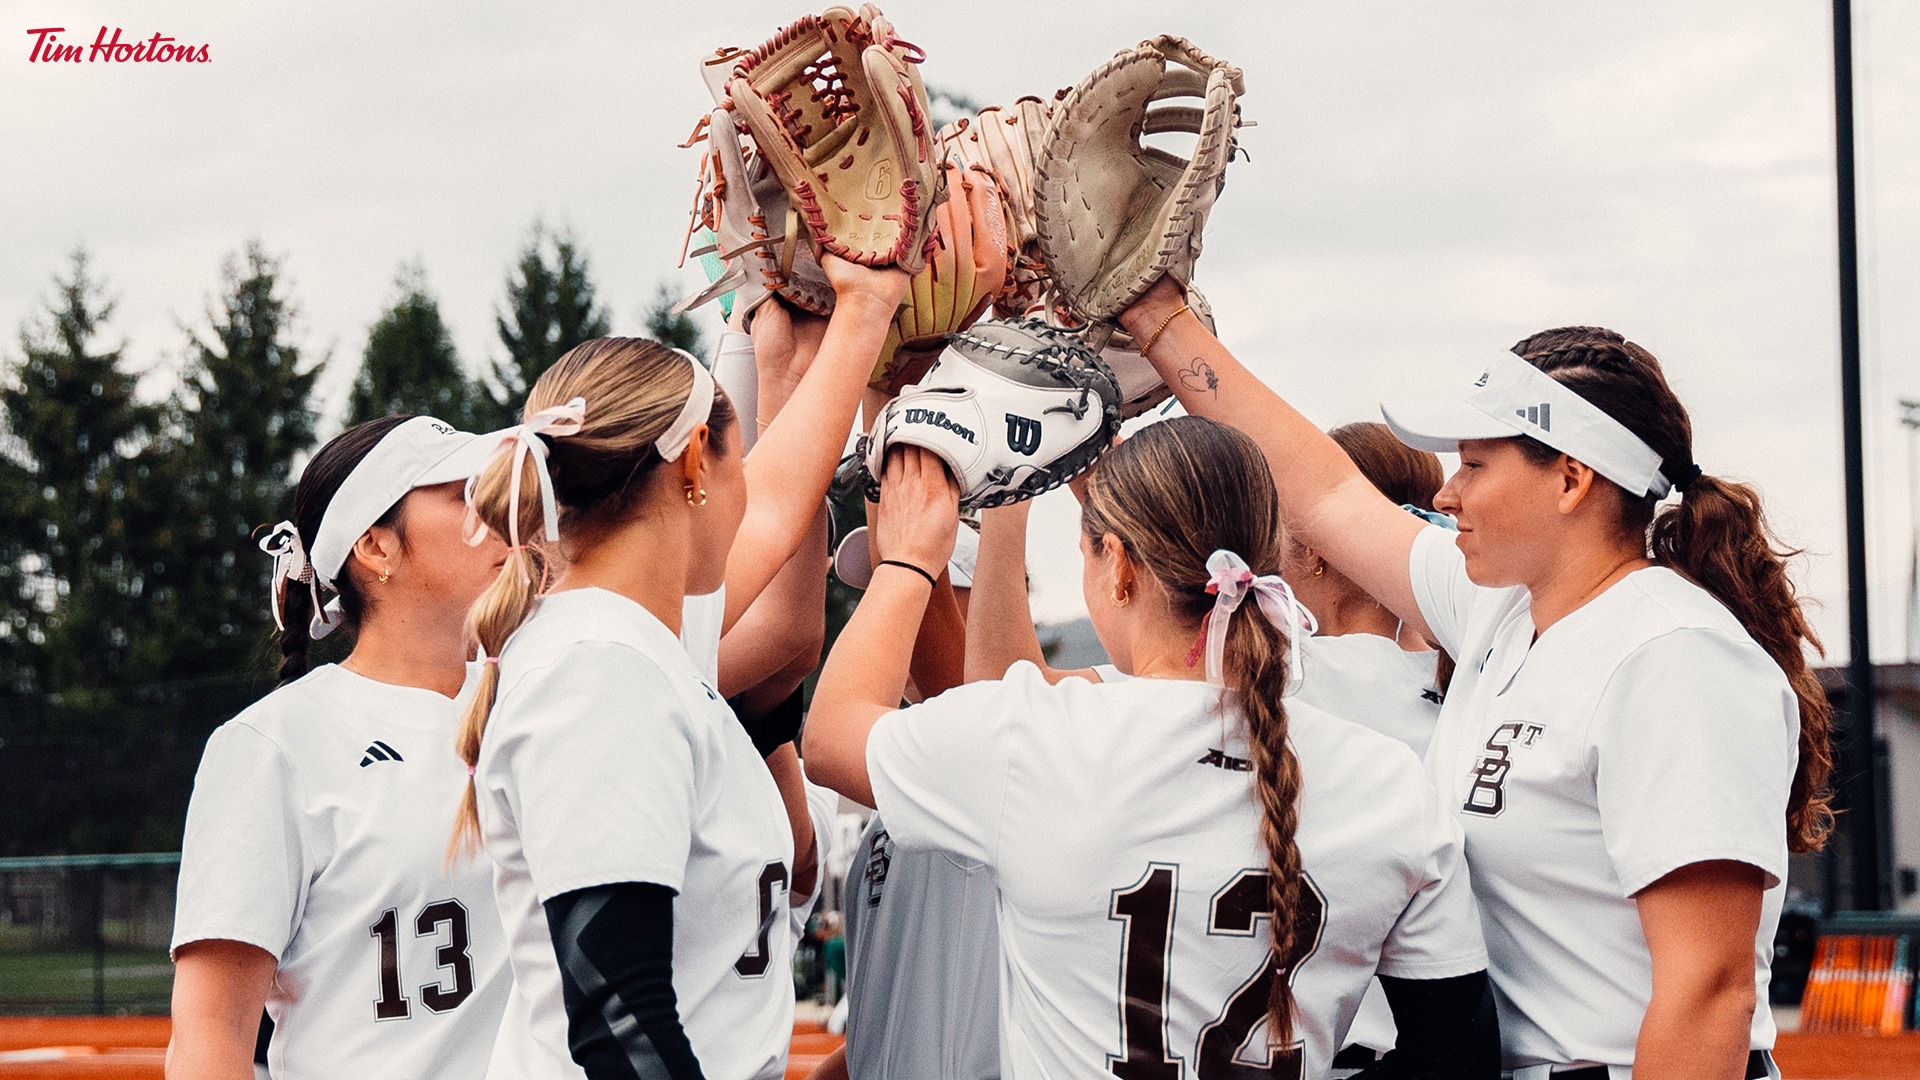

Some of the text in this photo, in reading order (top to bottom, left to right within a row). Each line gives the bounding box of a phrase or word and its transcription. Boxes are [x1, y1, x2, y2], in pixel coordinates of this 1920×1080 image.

[904, 408, 976, 445] Wilson
[1005, 412, 1042, 457] W
[369, 897, 476, 1022] 13
[1106, 862, 1328, 1080] 12
